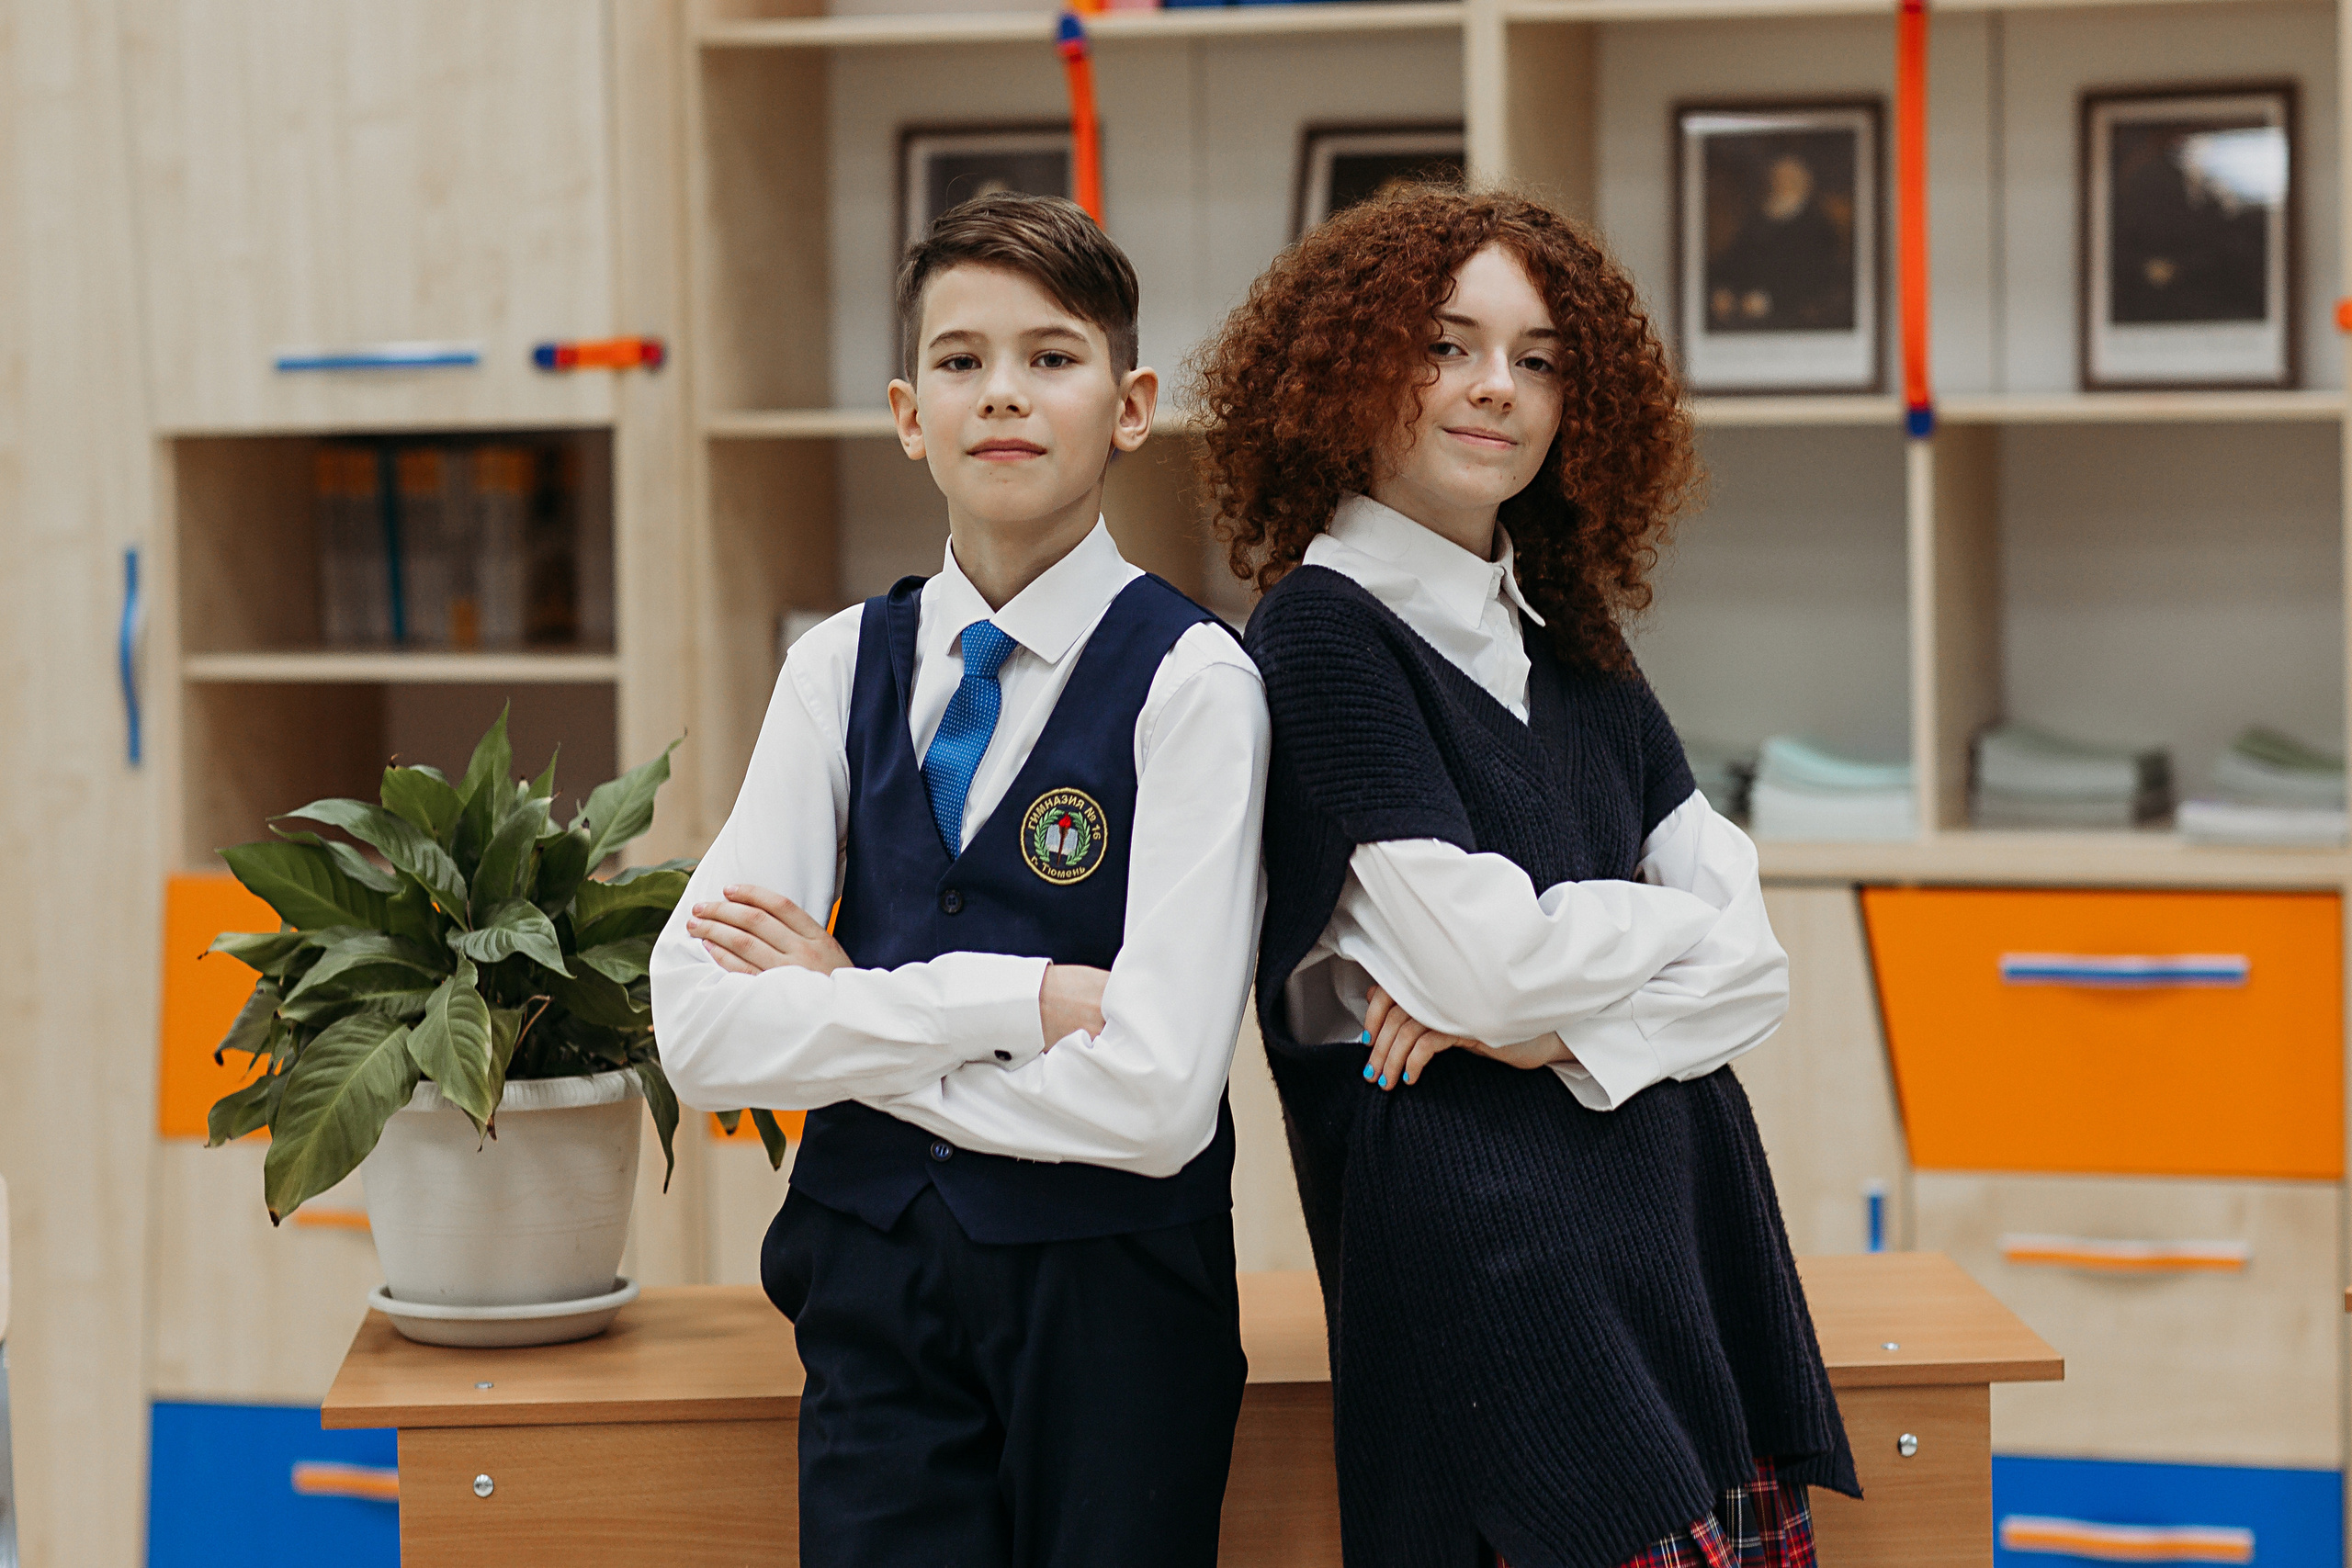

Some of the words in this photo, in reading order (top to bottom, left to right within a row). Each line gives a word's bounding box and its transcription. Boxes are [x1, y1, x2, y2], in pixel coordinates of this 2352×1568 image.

[1028, 795, 1085, 829] ГИМНАЗИЯ
[1084, 807, 1096, 822] №
[1091, 824, 1102, 840] 16
[1042, 862, 1086, 878] Тюмень
